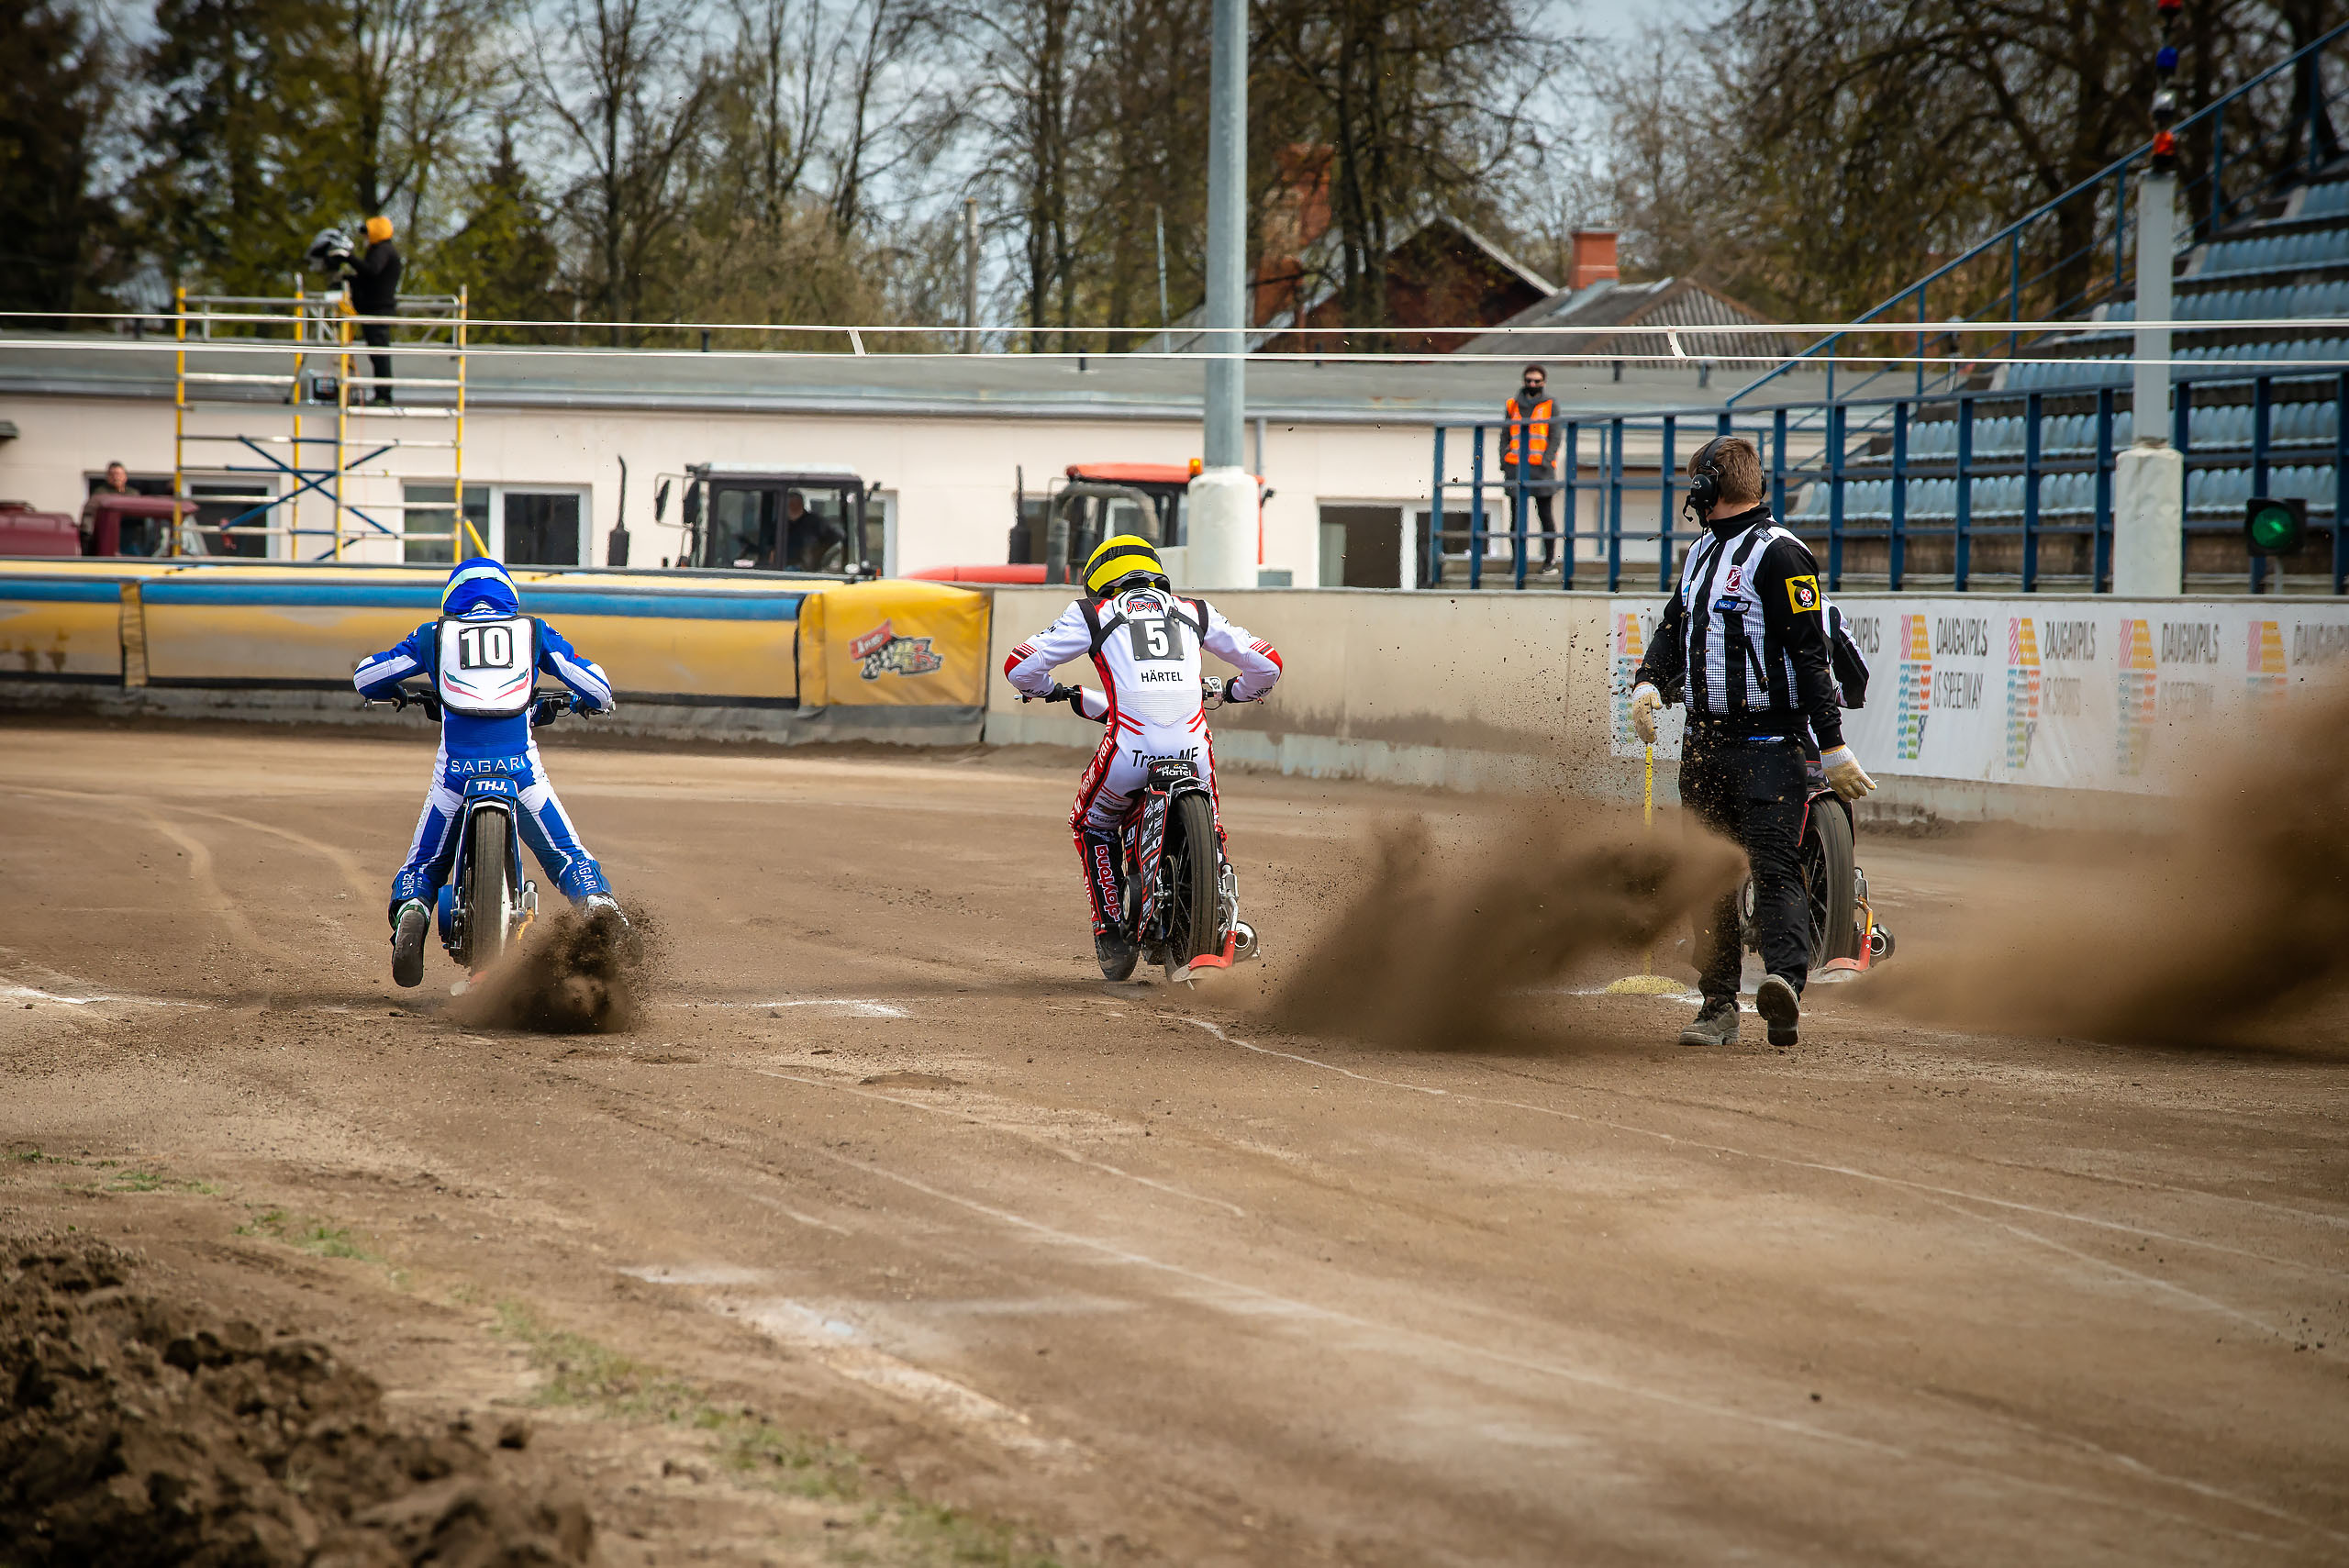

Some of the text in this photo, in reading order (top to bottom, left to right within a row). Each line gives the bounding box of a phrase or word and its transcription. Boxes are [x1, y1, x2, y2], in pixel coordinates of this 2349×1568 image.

[462, 628, 510, 667] 10
[1144, 620, 1170, 657] 5
[1847, 617, 1879, 653] AVPILS
[1936, 617, 1987, 656] DAUGAVPILS
[2045, 621, 2096, 661] DAUGAVPILS
[1141, 670, 1184, 683] HÄRTEL
[451, 756, 526, 773] SAGARI
